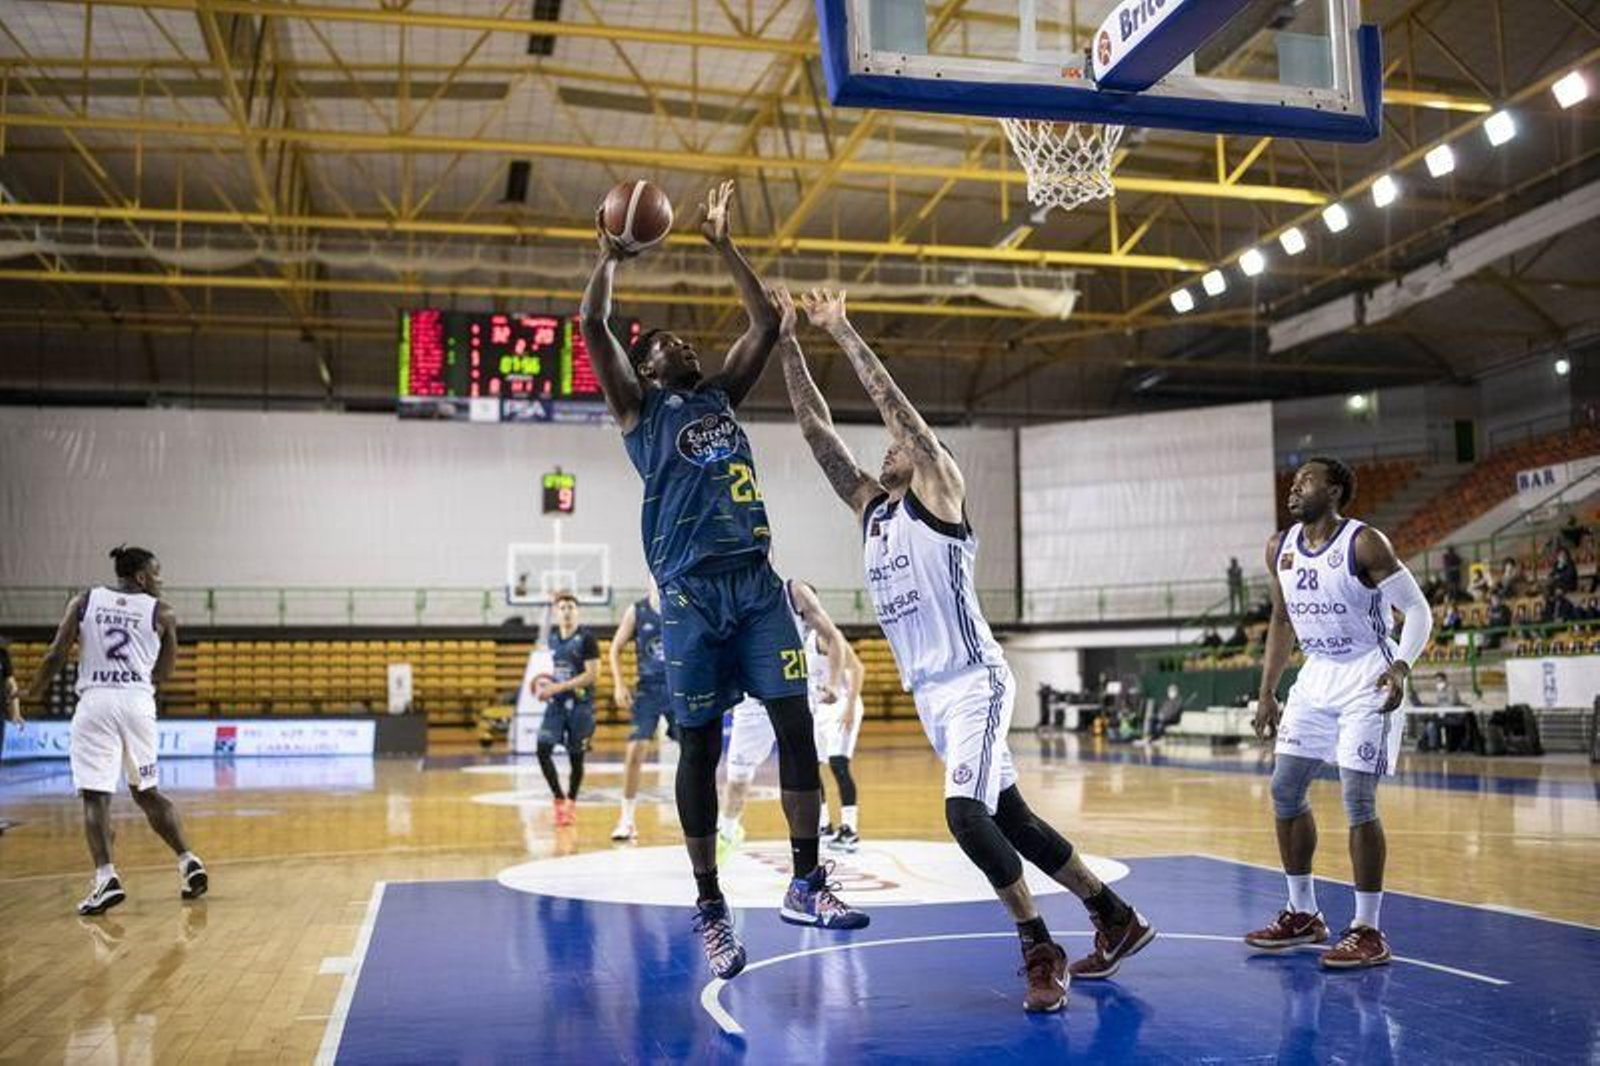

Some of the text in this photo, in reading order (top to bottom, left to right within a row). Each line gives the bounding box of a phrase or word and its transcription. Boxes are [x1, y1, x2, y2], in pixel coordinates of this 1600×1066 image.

[1518, 468, 1555, 490] BAR
[558, 487, 573, 510] 9
[1296, 567, 1319, 591] 28
[105, 627, 131, 662] 2
[92, 670, 143, 683] IVECO
